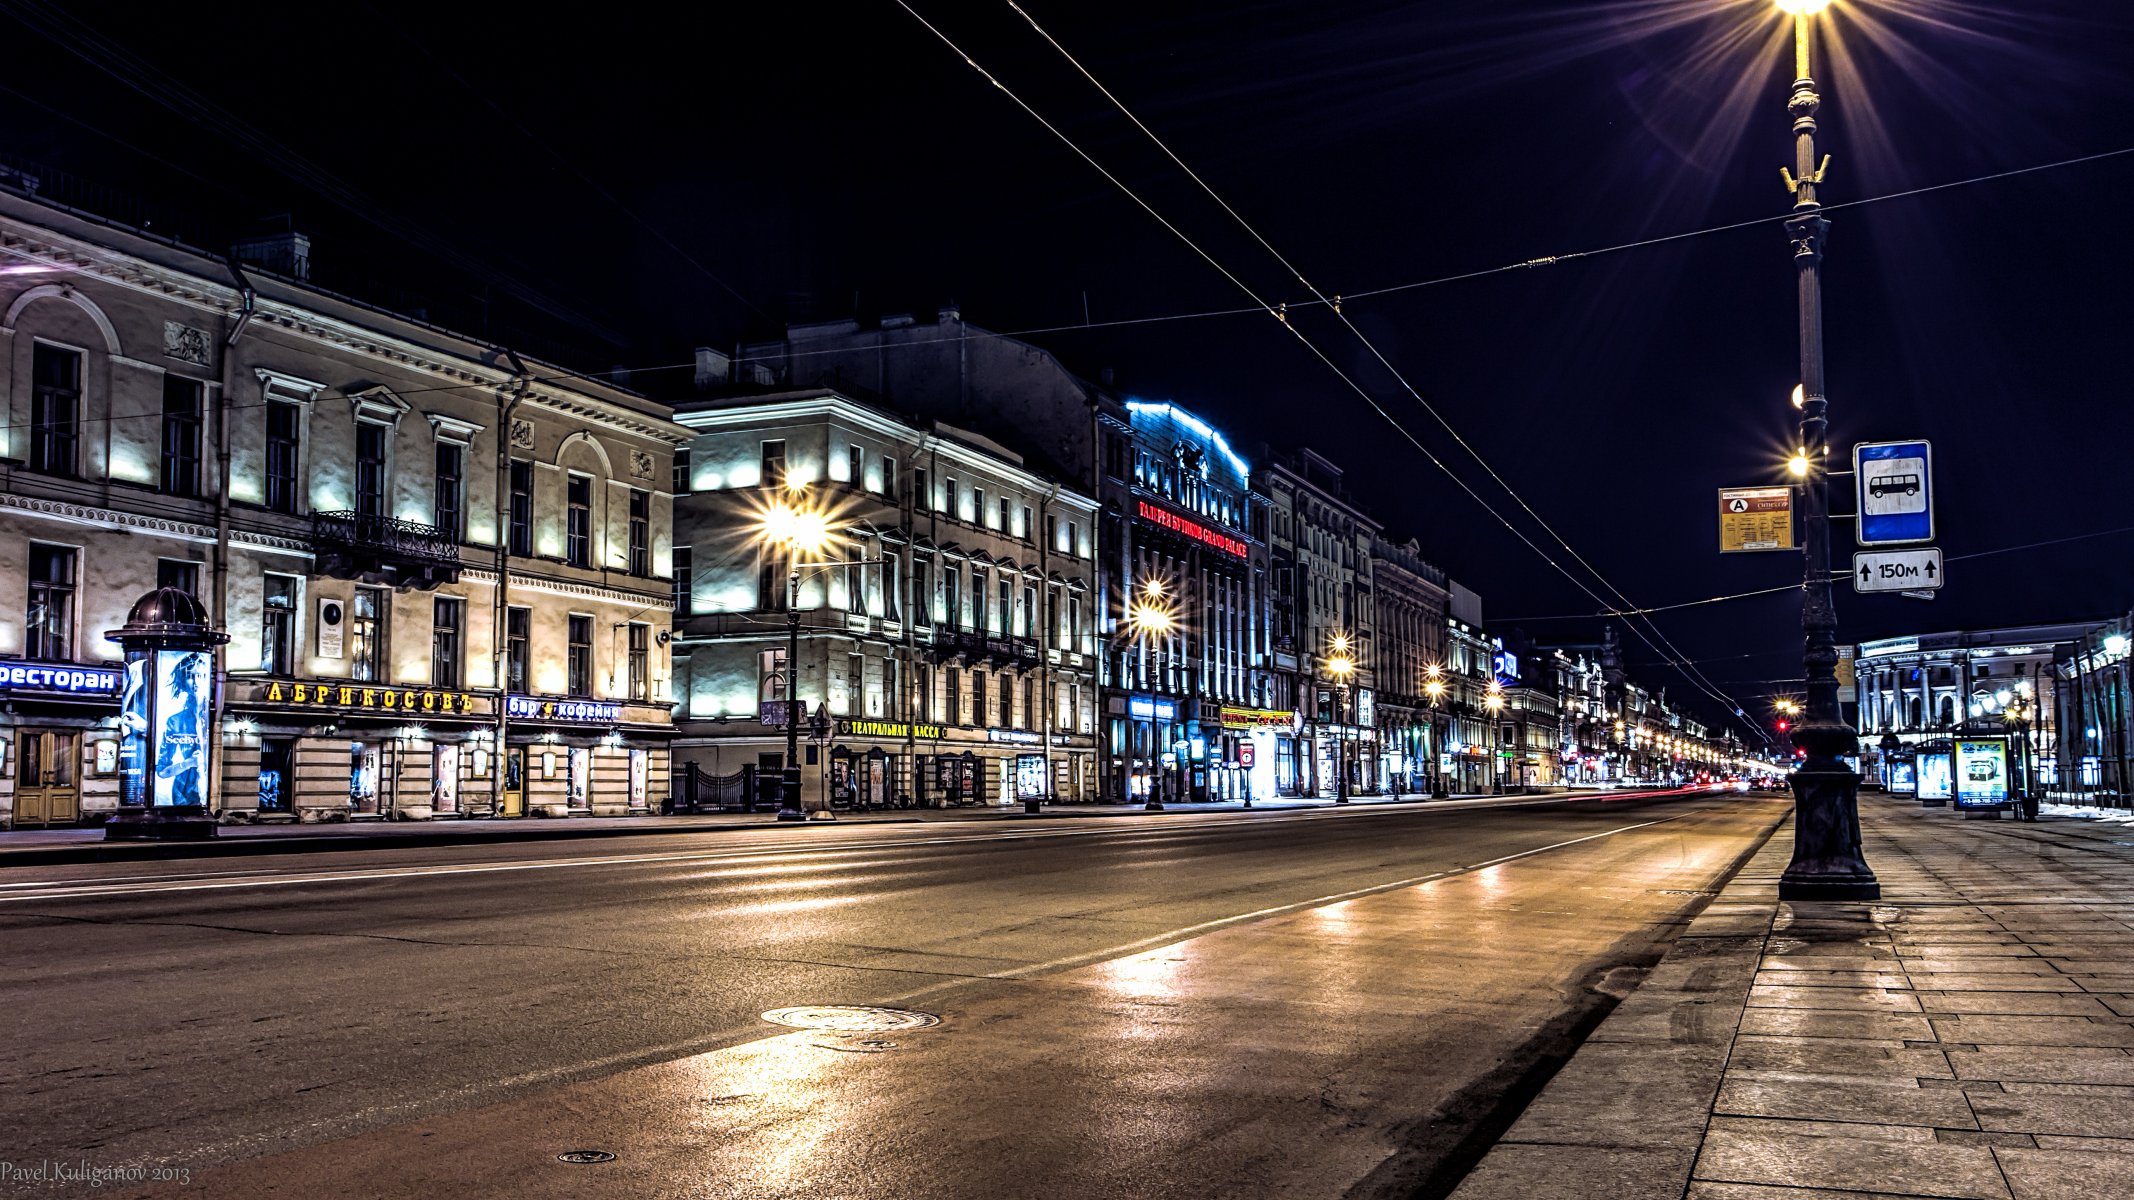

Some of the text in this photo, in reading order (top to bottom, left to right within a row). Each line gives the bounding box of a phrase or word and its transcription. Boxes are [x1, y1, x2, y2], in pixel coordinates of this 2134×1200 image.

[1139, 501, 1247, 558] ГАЛЕРЕЯ БУТИКОВ GRAND PALACE
[0, 667, 114, 691] ресторан
[268, 682, 473, 711] АБРИКОСОВЪ
[508, 697, 619, 721] бар кофейня
[851, 721, 939, 739] ТЕАТРАЛЬНАЯ КАССА
